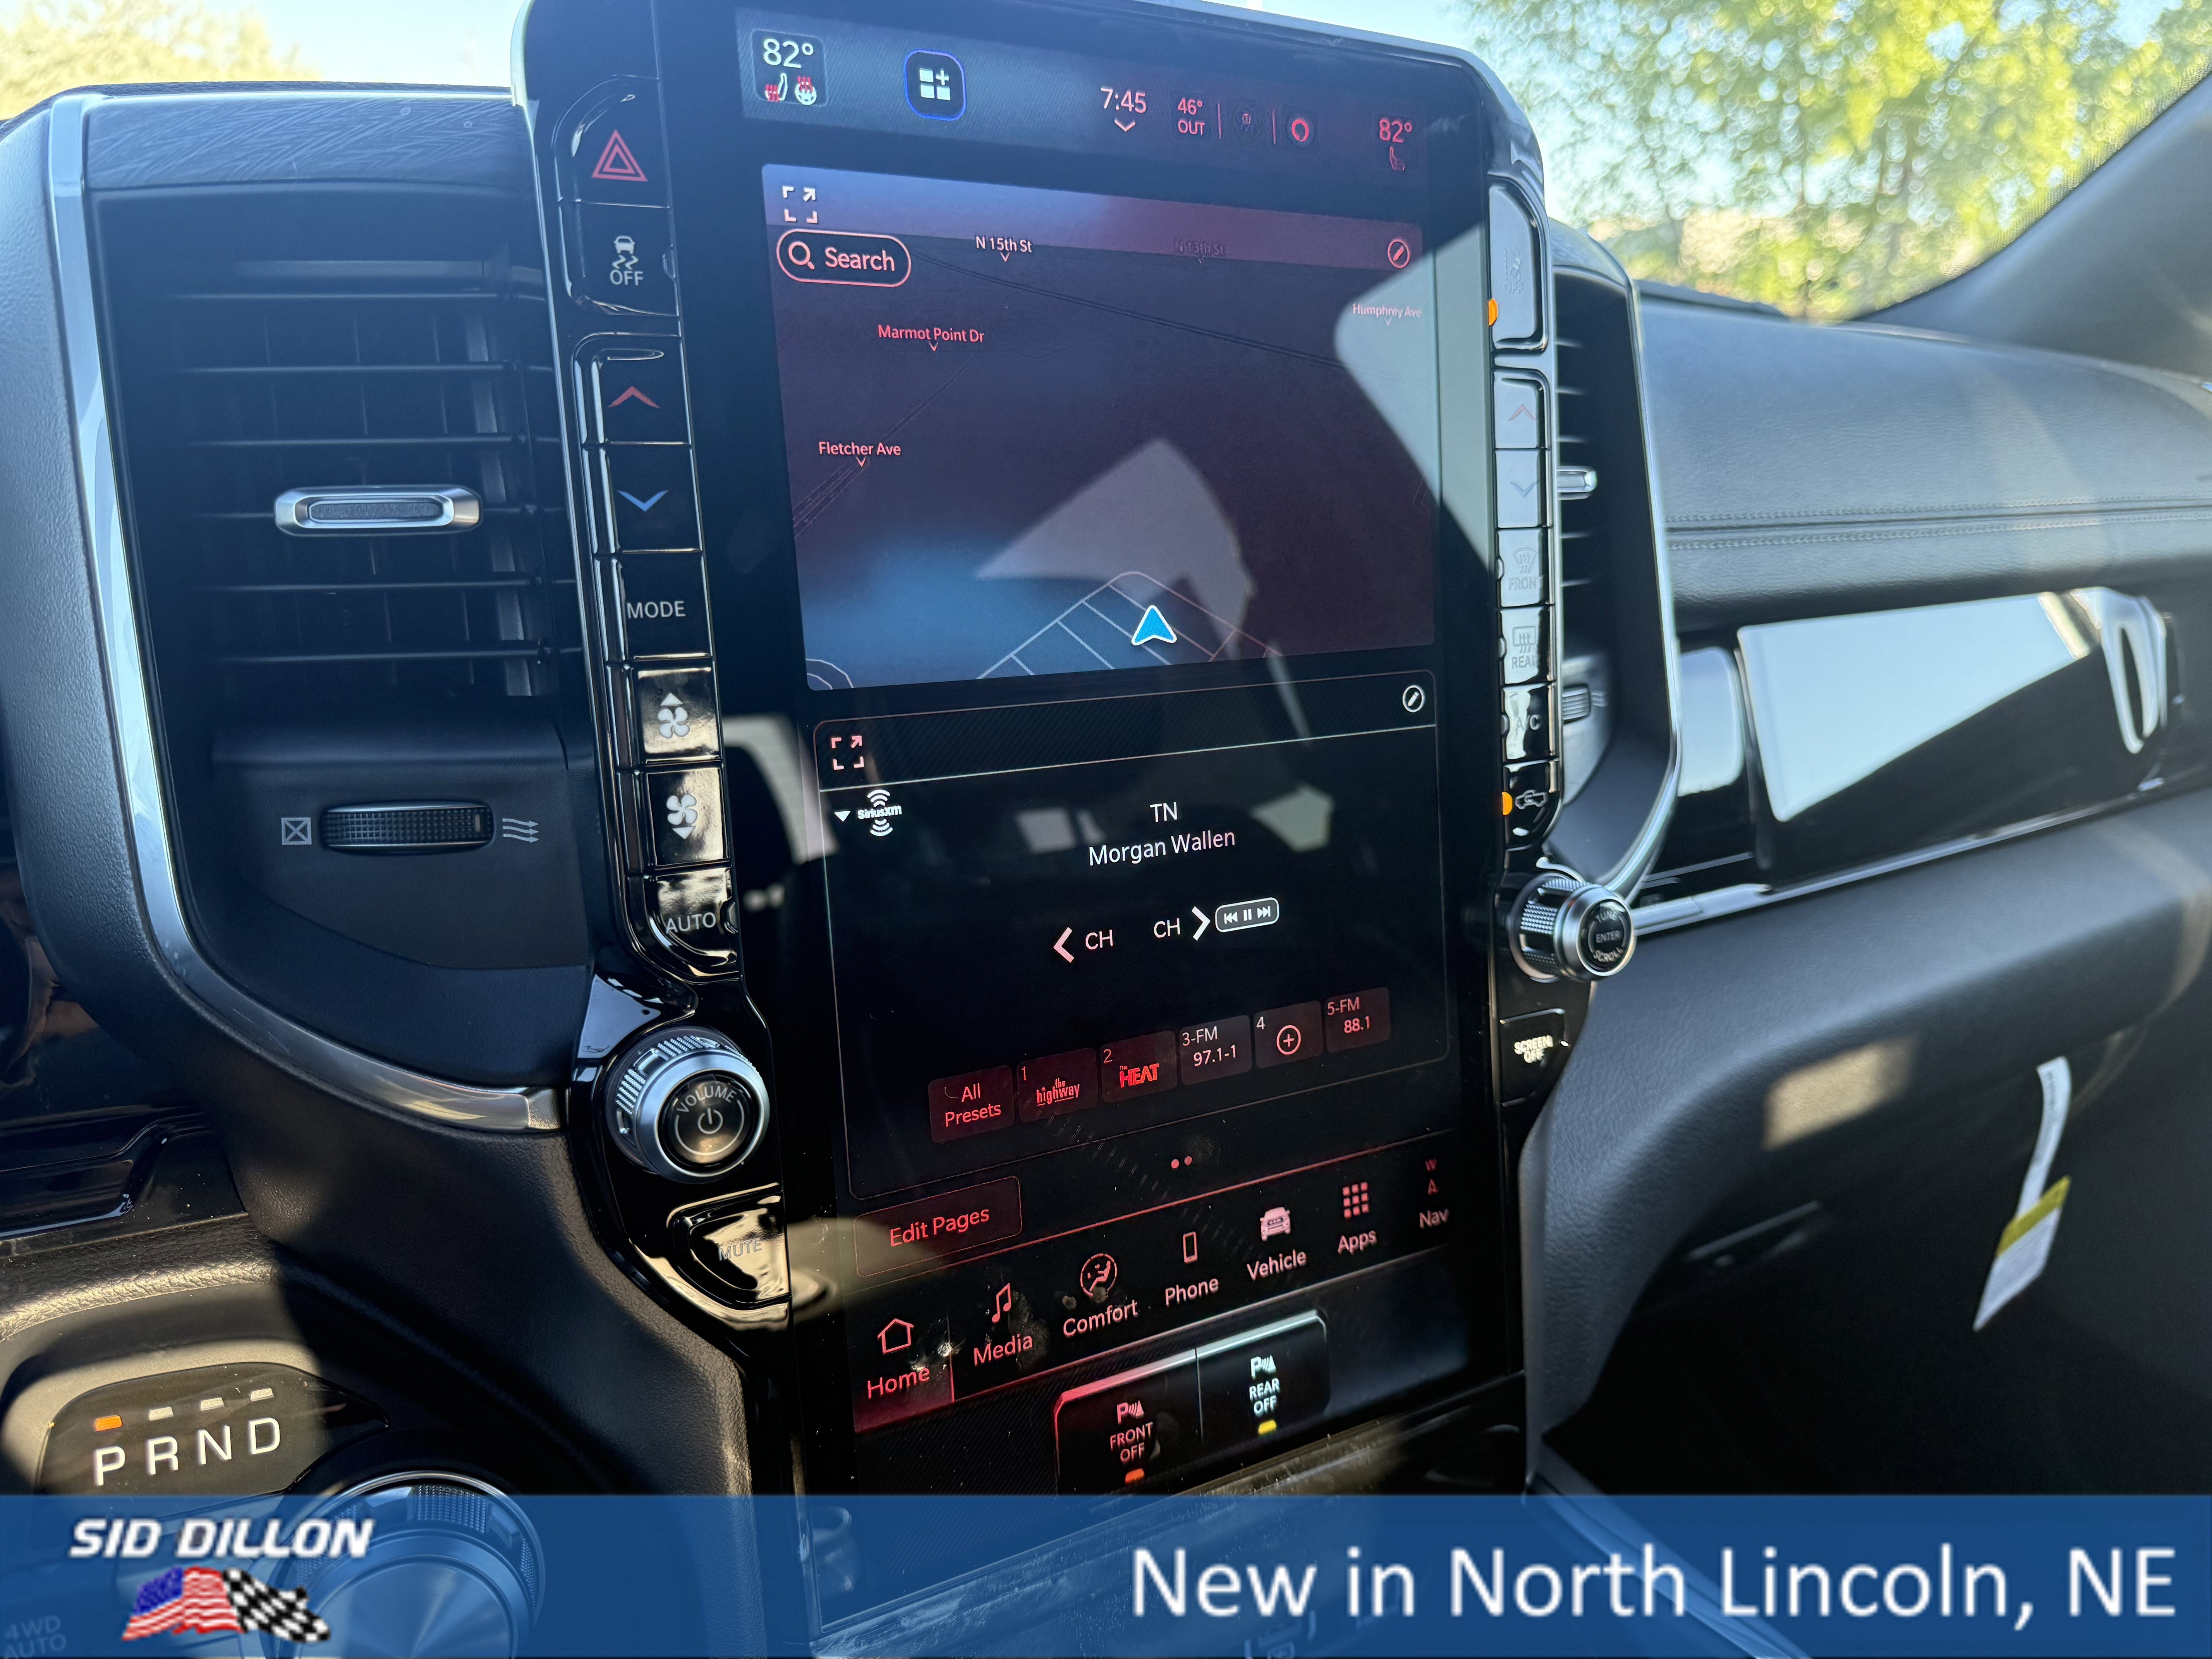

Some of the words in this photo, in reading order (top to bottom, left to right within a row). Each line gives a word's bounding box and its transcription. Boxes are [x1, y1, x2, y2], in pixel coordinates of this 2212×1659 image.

[763, 38, 814, 69] 82°
[1100, 86, 1147, 114] 7:45
[1177, 98, 1203, 115] 46°
[1178, 119, 1205, 136] OUT
[1379, 118, 1412, 143] 82°
[975, 235, 986, 249] N
[989, 237, 1017, 251] 15th
[1019, 239, 1032, 253] St
[824, 247, 895, 271] Search
[610, 270, 644, 286] OFF
[1504, 282, 1524, 294] OFF
[1353, 303, 1403, 319] Humphrey
[1405, 306, 1422, 318] Ave
[878, 324, 930, 340] Marmot
[933, 327, 967, 342] Point
[970, 329, 984, 343] Dr
[819, 441, 874, 455] Fletcher
[876, 442, 902, 456] Ave
[1508, 575, 1544, 591] FRONT
[627, 601, 686, 619] MODE
[1149, 801, 1178, 823] TN
[1089, 841, 1166, 866] Morgan
[1170, 830, 1235, 854] Wallen
[665, 912, 716, 934] AUTO
[1153, 917, 1181, 939] CH
[1595, 910, 1618, 924] TUNE
[1085, 929, 1114, 950] CH
[1595, 930, 1622, 943] ENTER
[1593, 947, 1624, 963] SCROLL
[1327, 996, 1360, 1016] 5-FM
[1256, 1016, 1266, 1030] 4
[1343, 1016, 1371, 1034] 88.1
[1182, 1025, 1218, 1046] 3-FM
[1514, 1035, 1553, 1055] SCREEN
[1103, 1049, 1113, 1063] 2
[1193, 1044, 1237, 1067] 97.1-1
[1523, 1048, 1544, 1063] OFF
[1021, 1066, 1027, 1081] 1
[1055, 1077, 1066, 1088] the
[1120, 1063, 1159, 1088] HEAT
[677, 1085, 737, 1114] VOLUME
[961, 1083, 981, 1103] All
[1036, 1084, 1080, 1104] highway
[945, 1103, 1001, 1127] Presets
[890, 1223, 928, 1247] Edit
[933, 1207, 990, 1236] Pages
[1419, 1208, 1450, 1230] Nav
[718, 1239, 762, 1261] MUTE
[1337, 1229, 1377, 1255] Apps
[1246, 1249, 1307, 1281] Vehicle
[1165, 1276, 1219, 1307] Phone
[1063, 1299, 1139, 1338] Comfort
[973, 1333, 1033, 1367] Media
[867, 1366, 930, 1399] Home
[1249, 1377, 1280, 1401] REAR
[1254, 1395, 1278, 1418] OFF
[1109, 1421, 1153, 1451] FRONT
[94, 1446, 125, 1486] P
[146, 1436, 179, 1475] R
[198, 1425, 233, 1465] N
[249, 1417, 280, 1455] D
[1120, 1443, 1145, 1464] OFF
[5, 1615, 61, 1640] 4WD
[3, 1633, 67, 1659] AUTO
